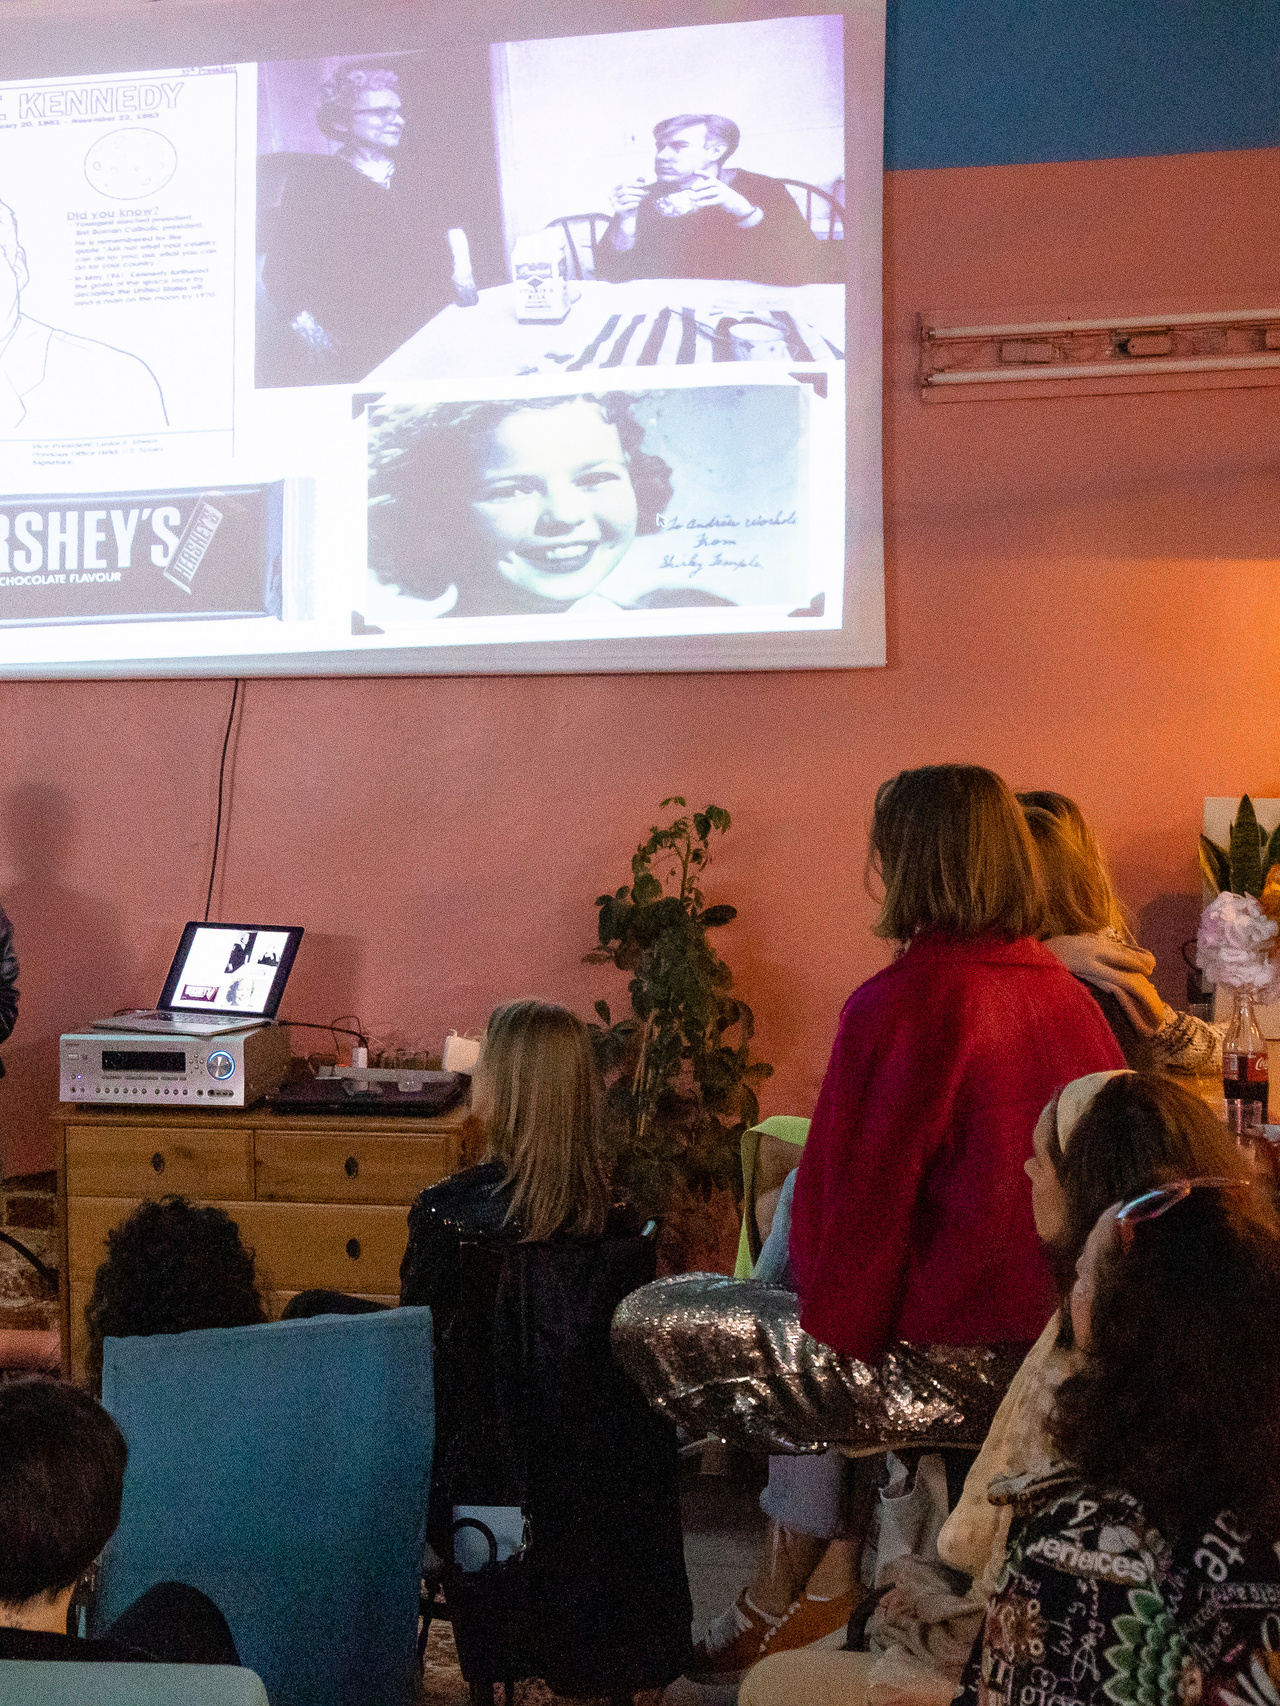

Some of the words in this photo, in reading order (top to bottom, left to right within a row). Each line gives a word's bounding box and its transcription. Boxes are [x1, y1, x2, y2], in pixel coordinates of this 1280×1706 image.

[19, 82, 185, 119] KENNEDY
[67, 210, 88, 221] Did
[91, 209, 115, 219] you
[119, 206, 160, 218] know?
[173, 508, 220, 584] HERSHEY'S
[70, 571, 122, 584] FLAVOUR
